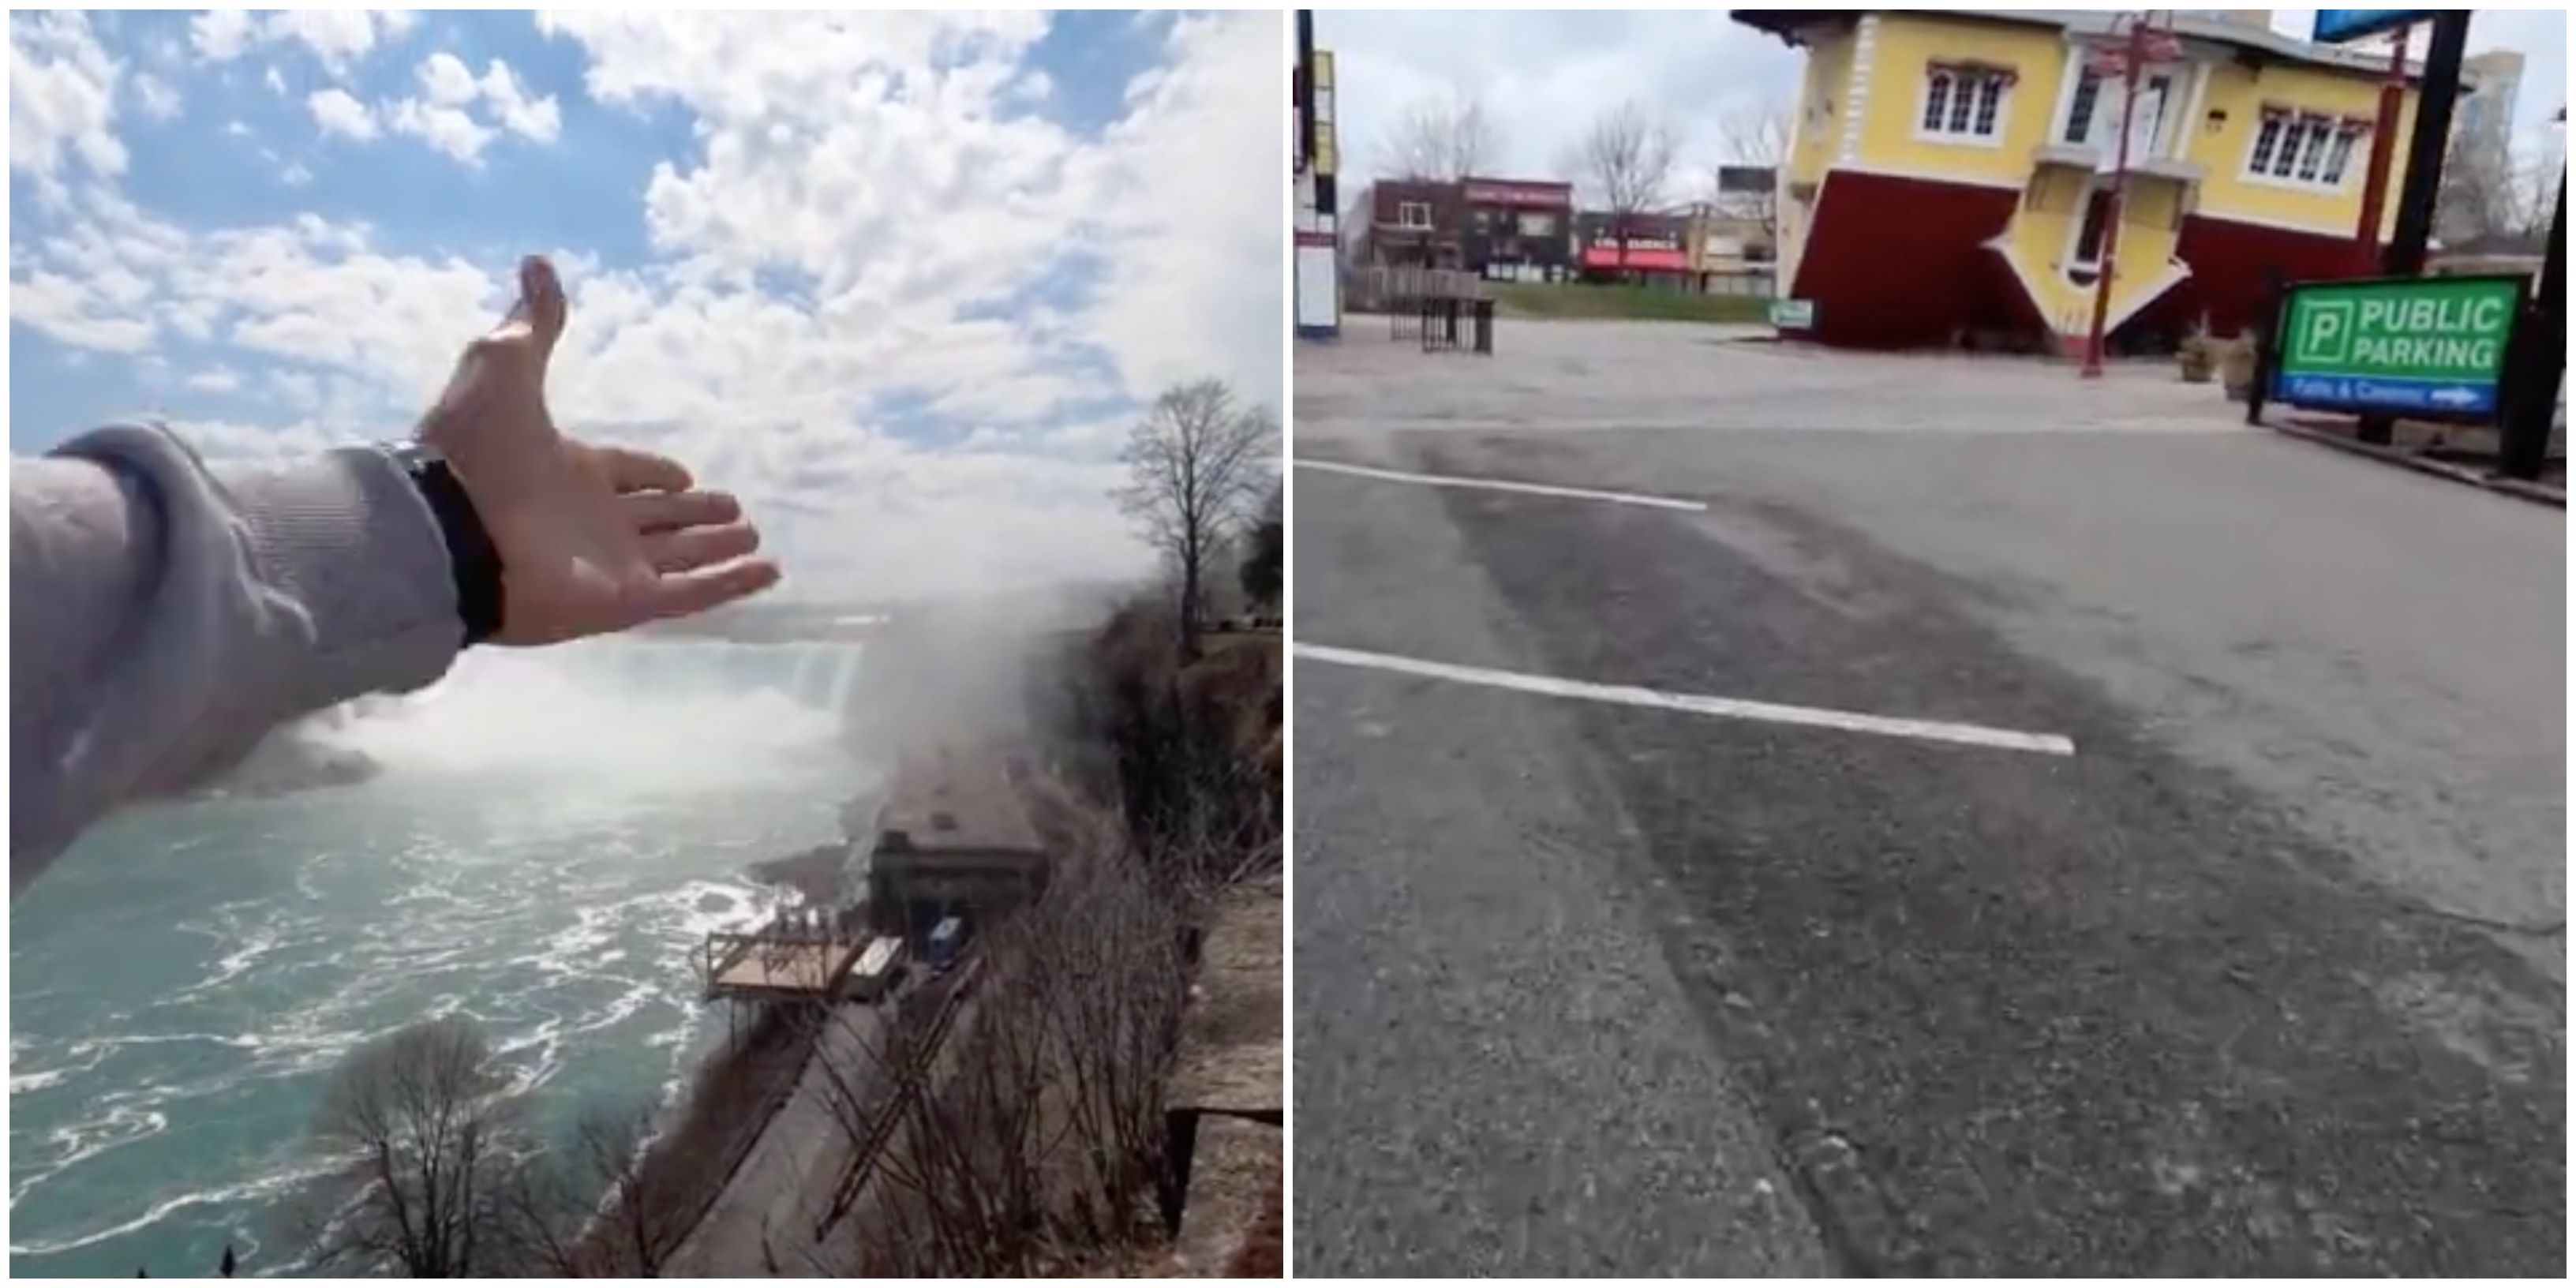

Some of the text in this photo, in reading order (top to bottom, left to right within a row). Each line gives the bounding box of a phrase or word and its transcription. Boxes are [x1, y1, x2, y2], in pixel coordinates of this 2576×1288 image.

[2309, 312, 2341, 354] P
[2358, 295, 2503, 333] PUBLIC
[2351, 336, 2497, 369] PARKING
